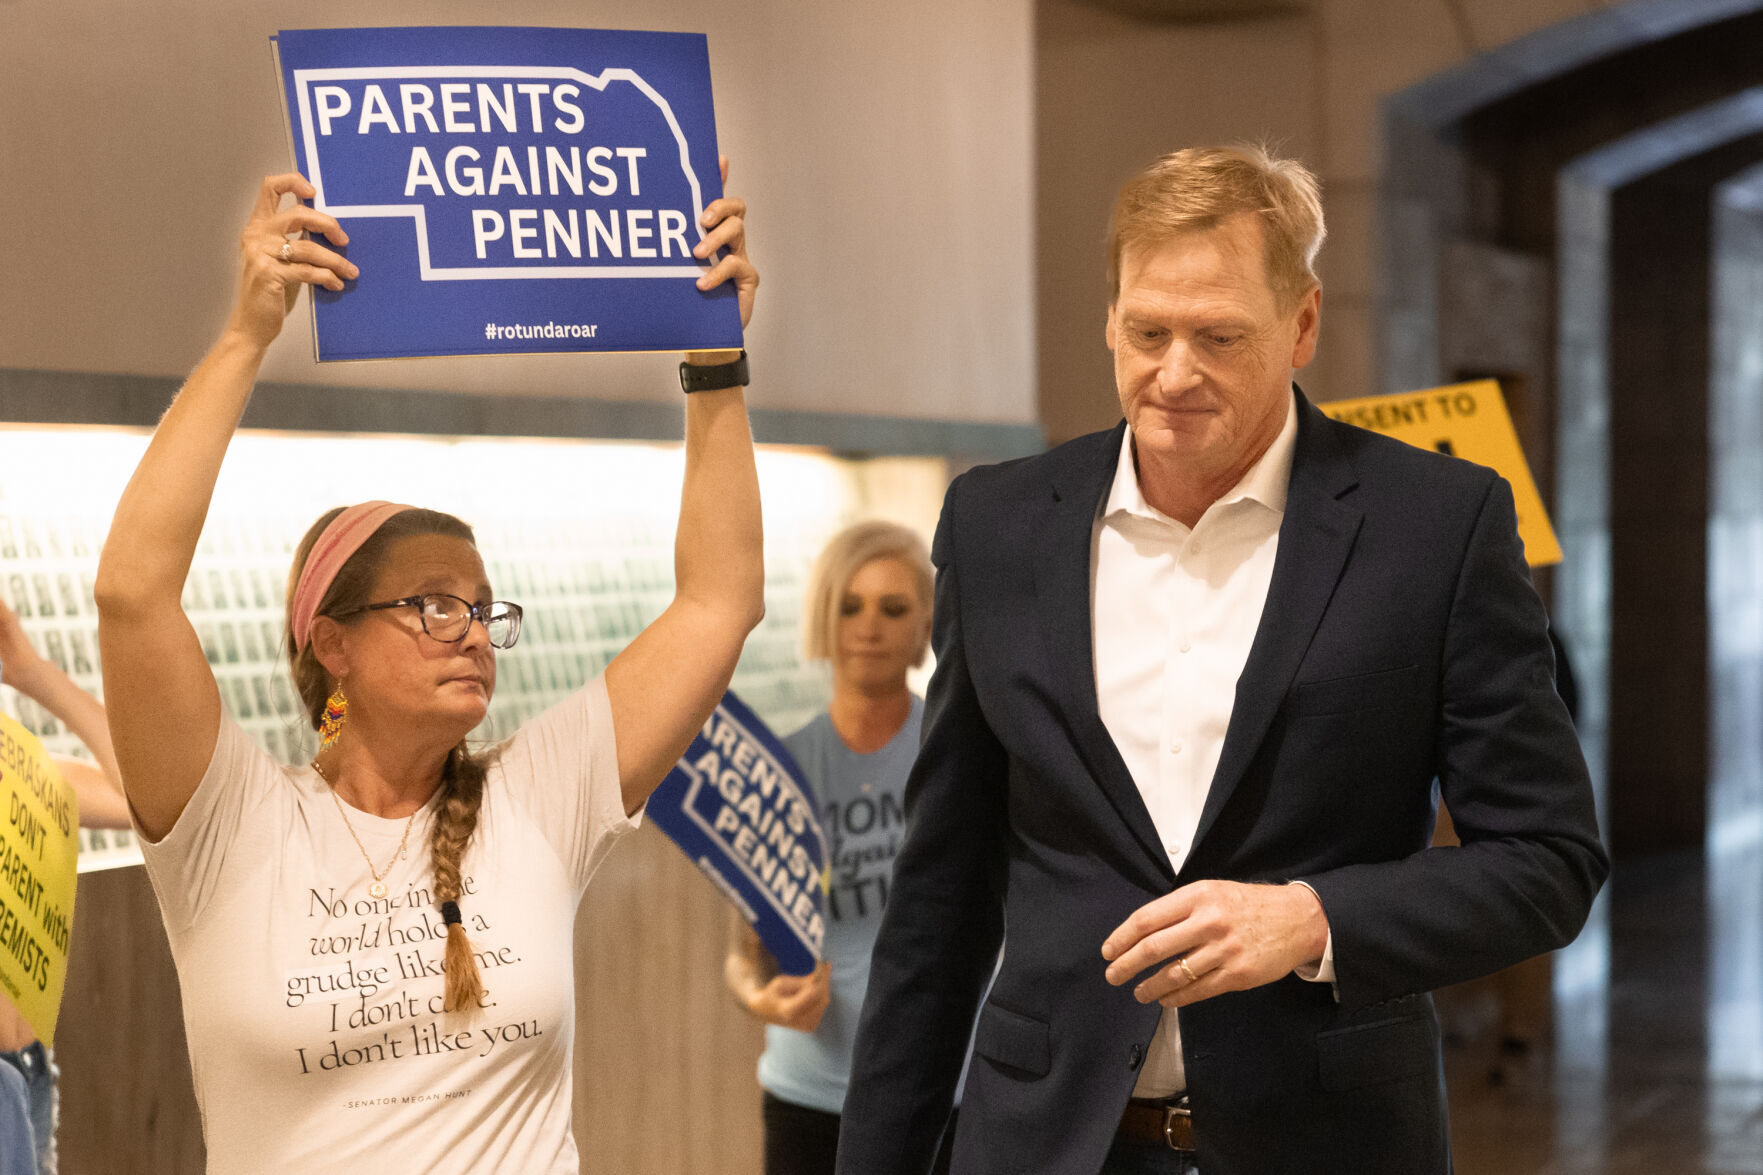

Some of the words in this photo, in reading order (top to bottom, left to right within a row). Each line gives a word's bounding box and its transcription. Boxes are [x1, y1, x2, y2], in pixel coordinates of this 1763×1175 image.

[313, 83, 585, 135] PARENTS
[403, 146, 647, 198] AGAINST
[471, 208, 692, 259] PENNER
[485, 321, 598, 341] #rotundaroar
[1436, 391, 1477, 417] TO
[10, 791, 46, 861] DON'T
[694, 750, 820, 894] AGAINST
[308, 888, 347, 918] No
[408, 883, 433, 908] in
[42, 901, 69, 957] with
[310, 922, 382, 956] world
[387, 913, 466, 947] hol
[471, 914, 491, 932] a
[286, 960, 389, 1008] grudge
[328, 1003, 340, 1033] I
[349, 990, 420, 1029] don't
[428, 988, 497, 1015] ce.
[295, 1048, 311, 1075] I
[319, 1033, 403, 1071] don't
[411, 1022, 472, 1057] like
[479, 1019, 543, 1058] you.
[401, 1093, 440, 1104] MEGAN
[445, 1089, 472, 1100] HUNT
